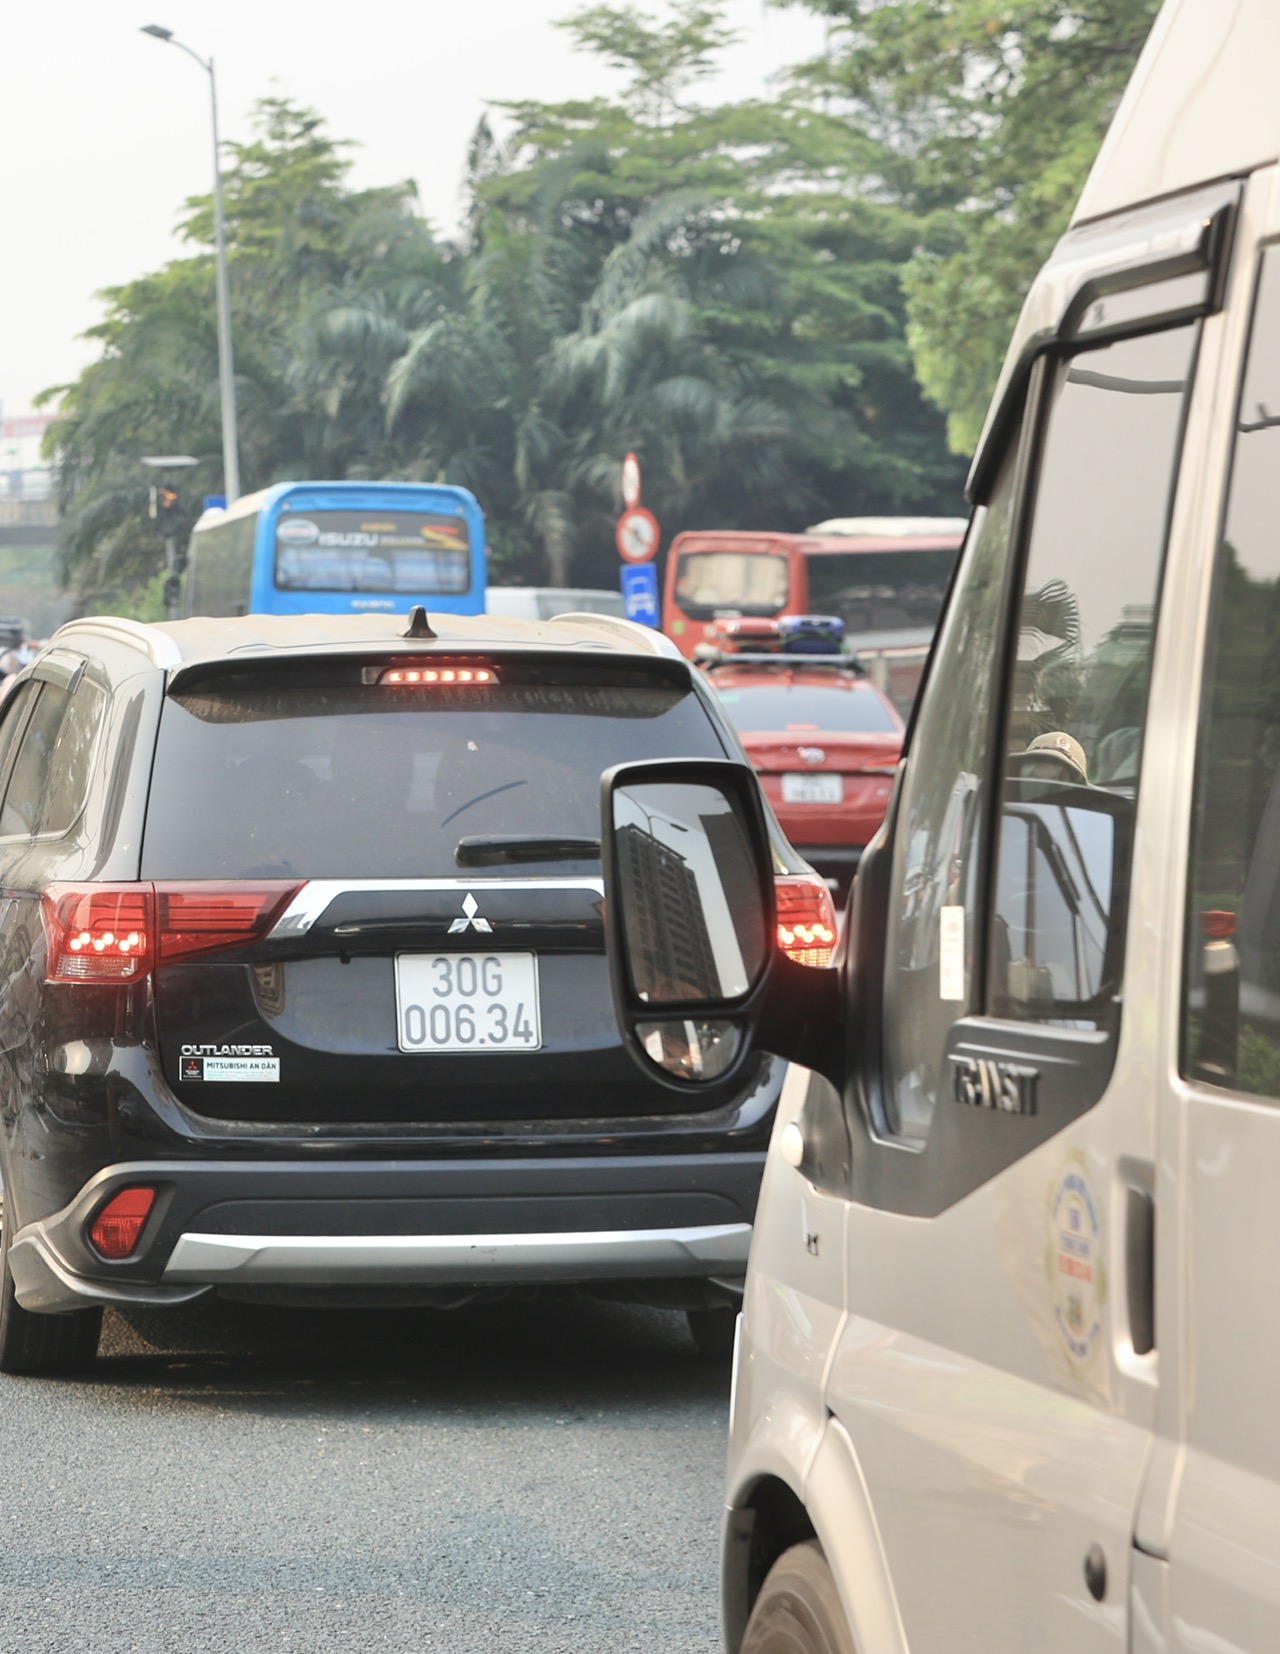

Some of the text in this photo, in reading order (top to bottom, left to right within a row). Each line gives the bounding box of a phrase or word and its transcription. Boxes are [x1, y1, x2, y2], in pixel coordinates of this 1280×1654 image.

[318, 531, 379, 547] ISUZU
[431, 956, 503, 998] 30G
[404, 1003, 534, 1045] 006.34
[181, 1044, 274, 1056] OUTLANDER
[206, 1062, 248, 1070] MITSUBISHI
